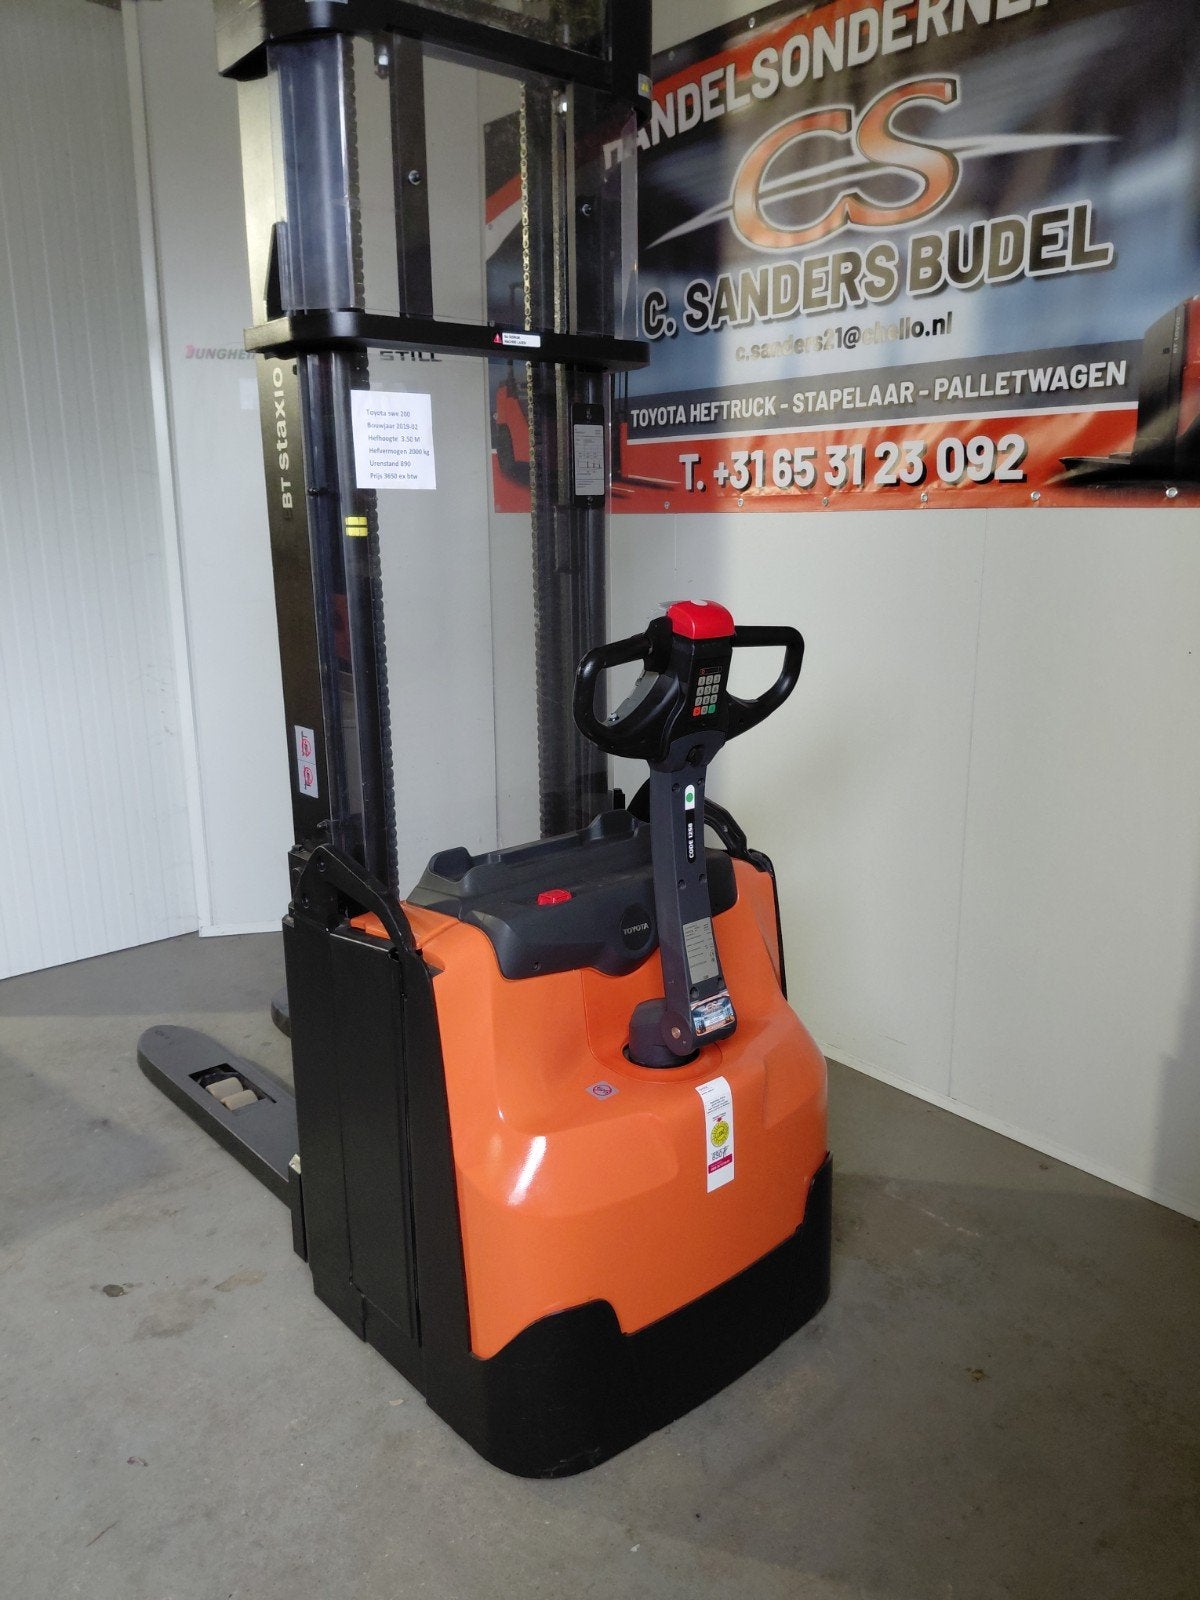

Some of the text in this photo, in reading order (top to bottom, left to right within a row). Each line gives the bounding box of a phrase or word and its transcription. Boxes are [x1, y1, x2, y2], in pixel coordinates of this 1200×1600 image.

[642, 199, 1115, 340] C. SANDERS BUDEL
[735, 311, 953, 362] c.sanders21@chello.nl
[379, 350, 442, 362] STILL
[630, 406, 687, 427] TOYOTA
[690, 396, 776, 423] HEFTRUCK
[792, 381, 913, 414] STAPELAAR
[934, 360, 1128, 400] PALLETWAGEN
[366, 409, 387, 417] Toyota
[400, 410, 411, 418] 200
[367, 422, 395, 430] Bouwjaar
[368, 435, 399, 443] Hefhoogte
[369, 447, 408, 456] Hefvermogen
[679, 434, 1028, 490] T. +31 65 31 23 092
[280, 477, 293, 508] BT
[622, 922, 650, 936] TOYOTA
